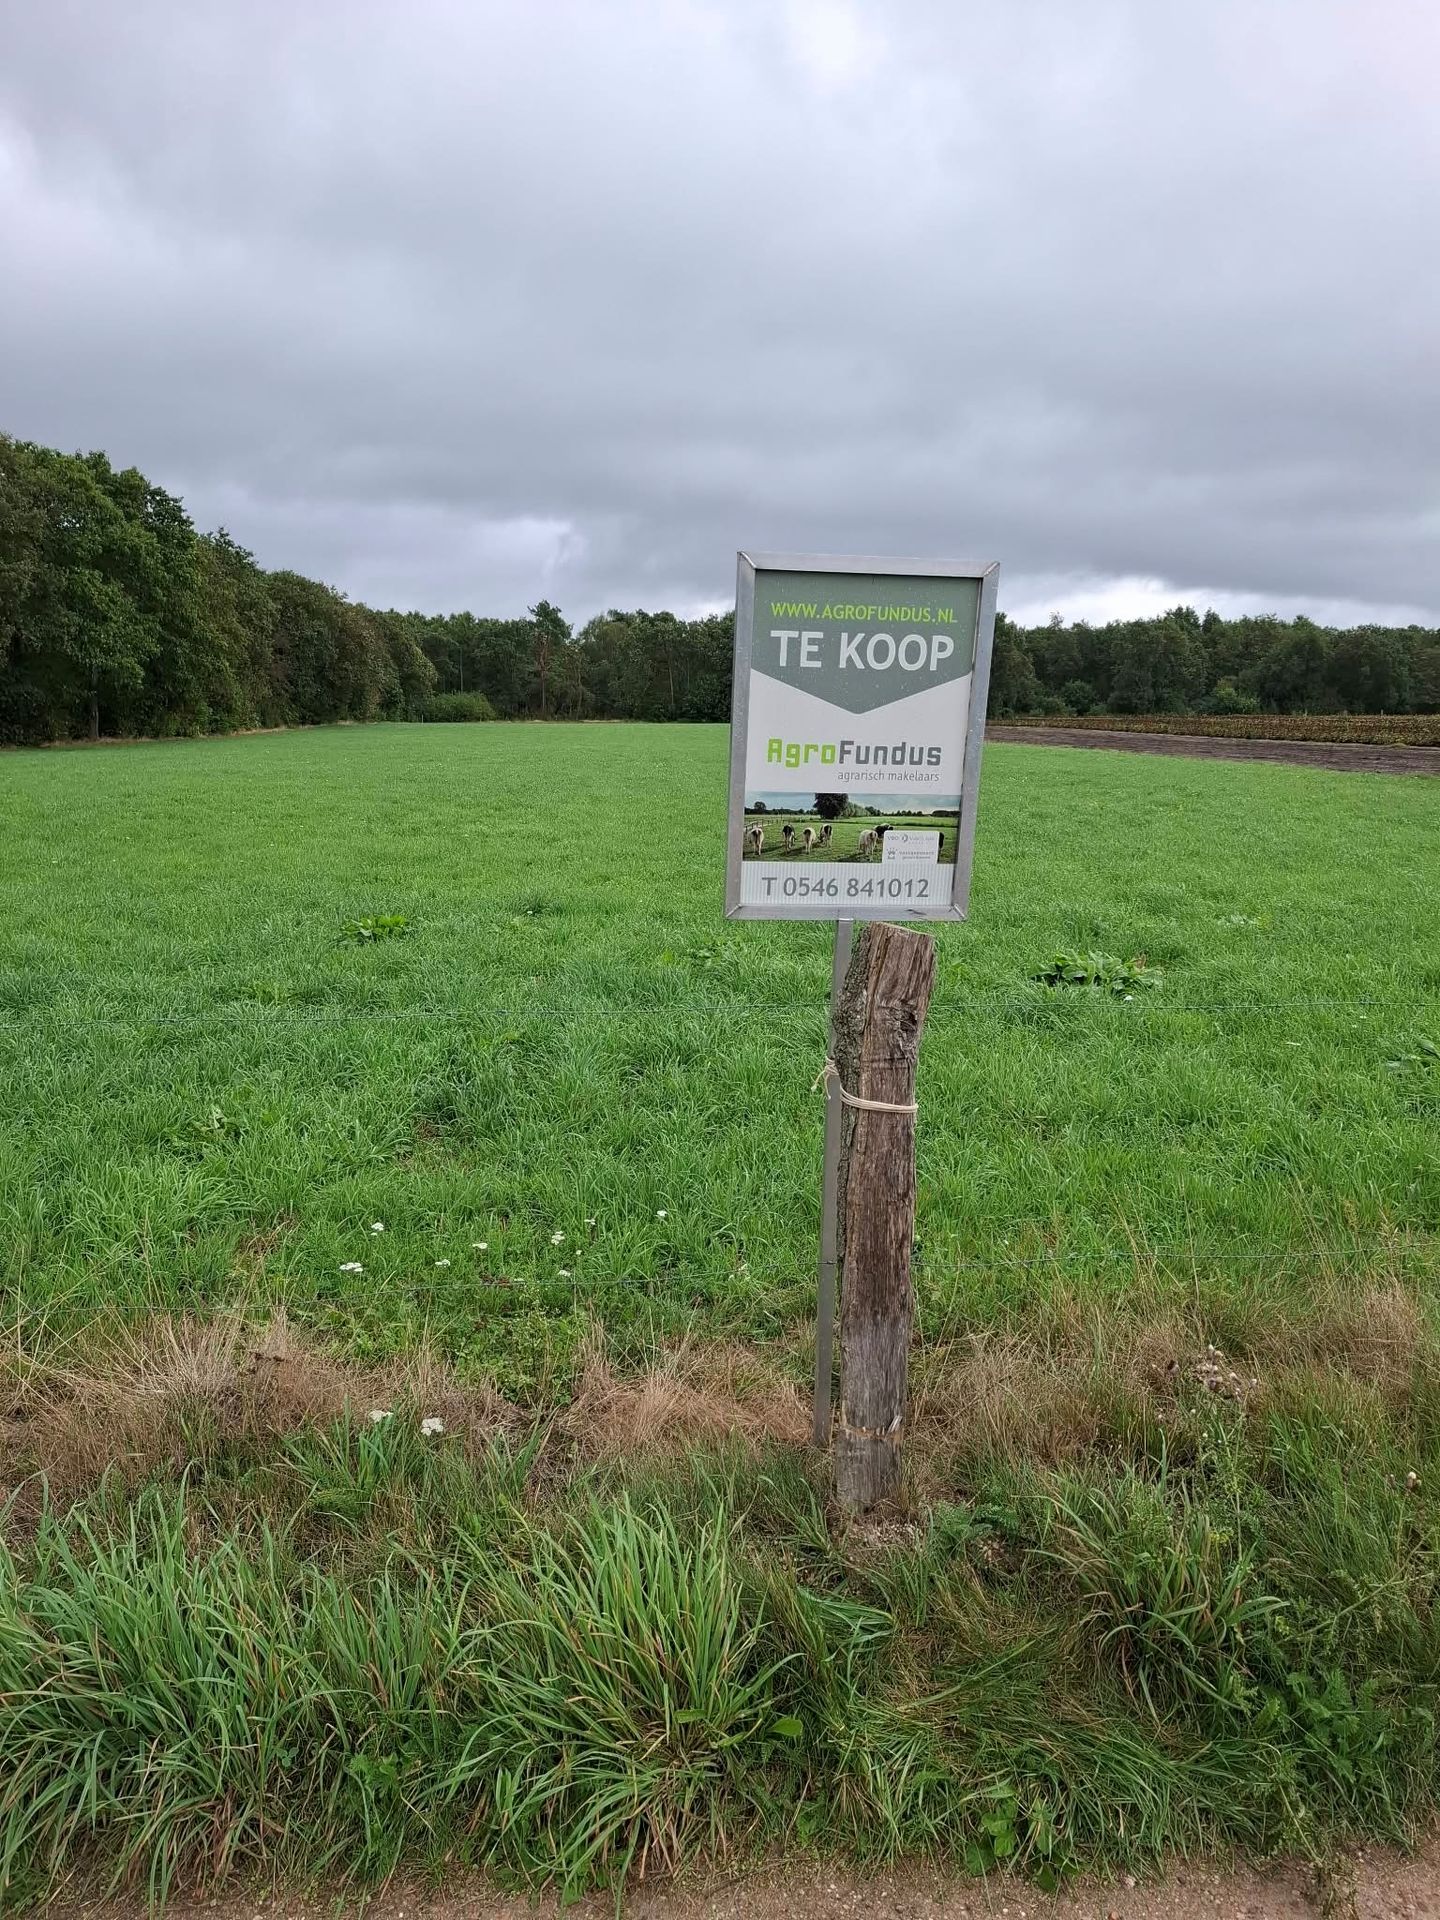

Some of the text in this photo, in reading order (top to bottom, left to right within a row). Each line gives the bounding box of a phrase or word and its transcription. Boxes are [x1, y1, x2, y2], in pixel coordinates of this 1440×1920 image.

[771, 602, 958, 623] WWW.AGROFUNDUS.NL
[770, 630, 955, 671] TE KOOP
[767, 738, 942, 768] AgroFundus
[837, 769, 940, 783] agrarisch makelaars
[762, 877, 929, 898] T 0546 841012
